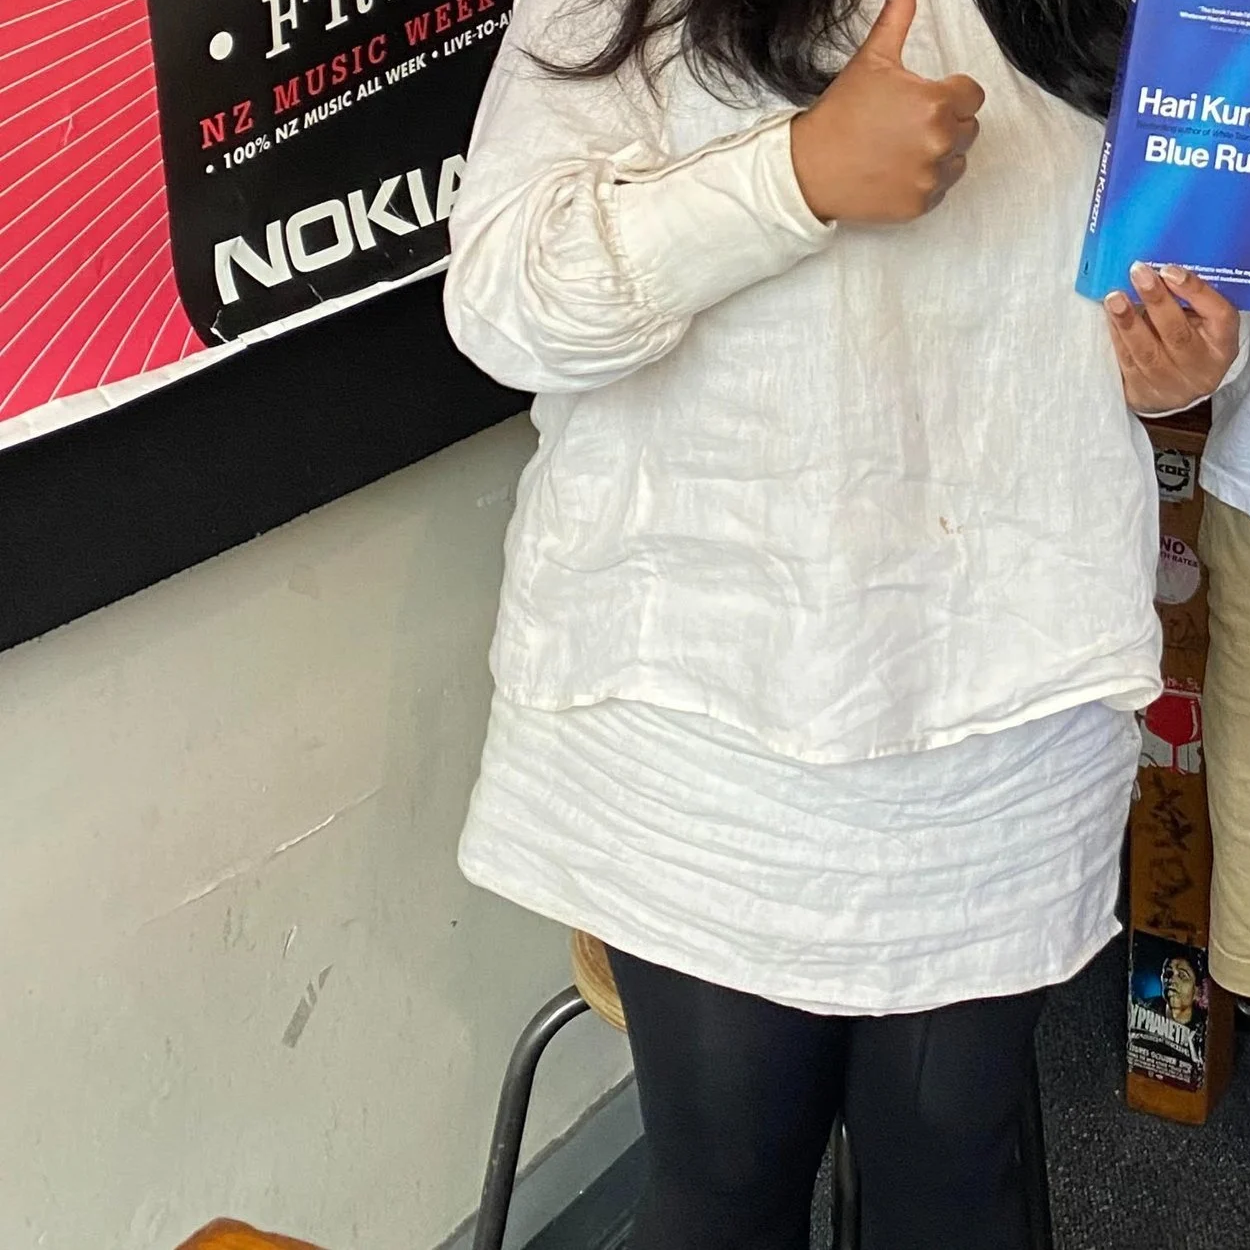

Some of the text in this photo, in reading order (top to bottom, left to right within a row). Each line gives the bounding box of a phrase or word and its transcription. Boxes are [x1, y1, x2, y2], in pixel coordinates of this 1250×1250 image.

[200, 100, 255, 150] NZ
[272, 33, 388, 115] MUSIC
[222, 9, 514, 170] 100% NZ MUSIC ALL WEEK LIVE-TO-AI
[1138, 86, 1198, 120] Hari
[1099, 141, 1112, 176] Hari
[1145, 135, 1210, 168] Blue
[1090, 174, 1106, 233] Kunzru
[214, 153, 468, 306] NOKIA
[1160, 535, 1186, 555] NO
